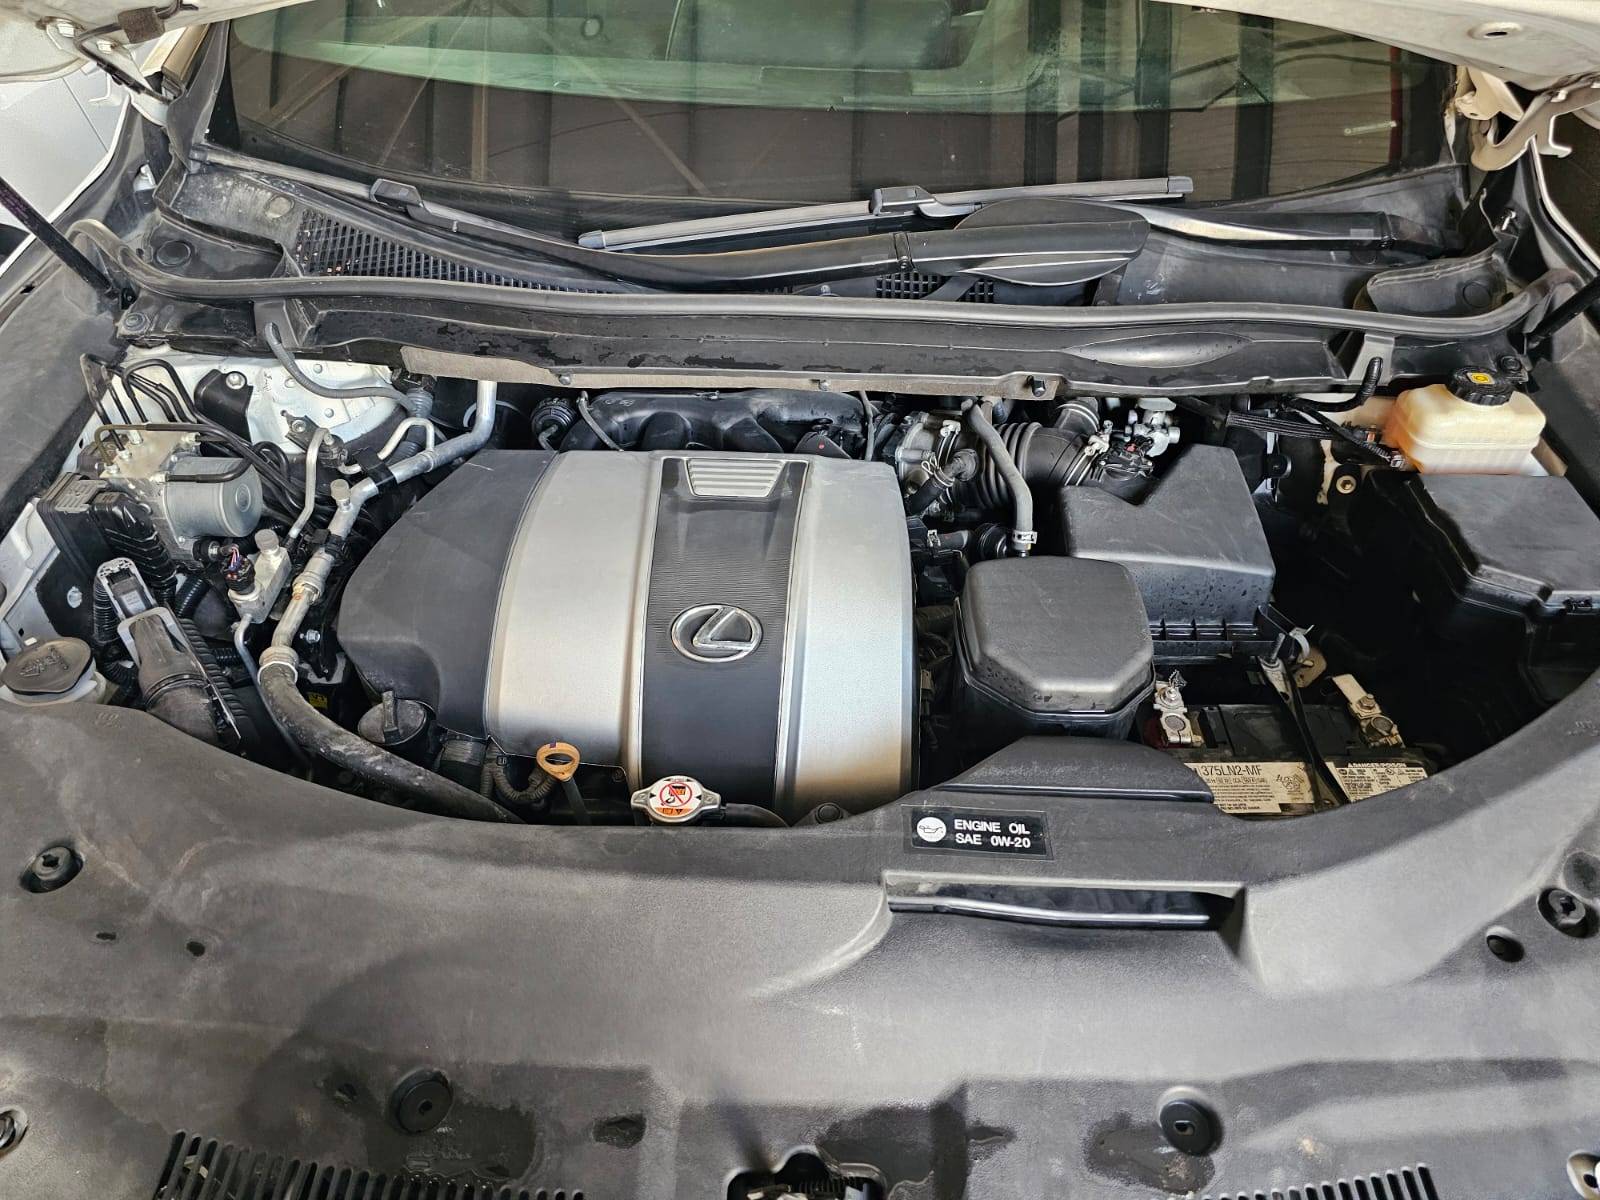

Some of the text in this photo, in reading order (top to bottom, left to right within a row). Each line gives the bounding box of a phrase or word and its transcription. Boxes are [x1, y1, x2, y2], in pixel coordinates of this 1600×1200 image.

[954, 819, 1031, 835] ENGINE OIL
[955, 832, 1031, 848] SAE 0W-20
